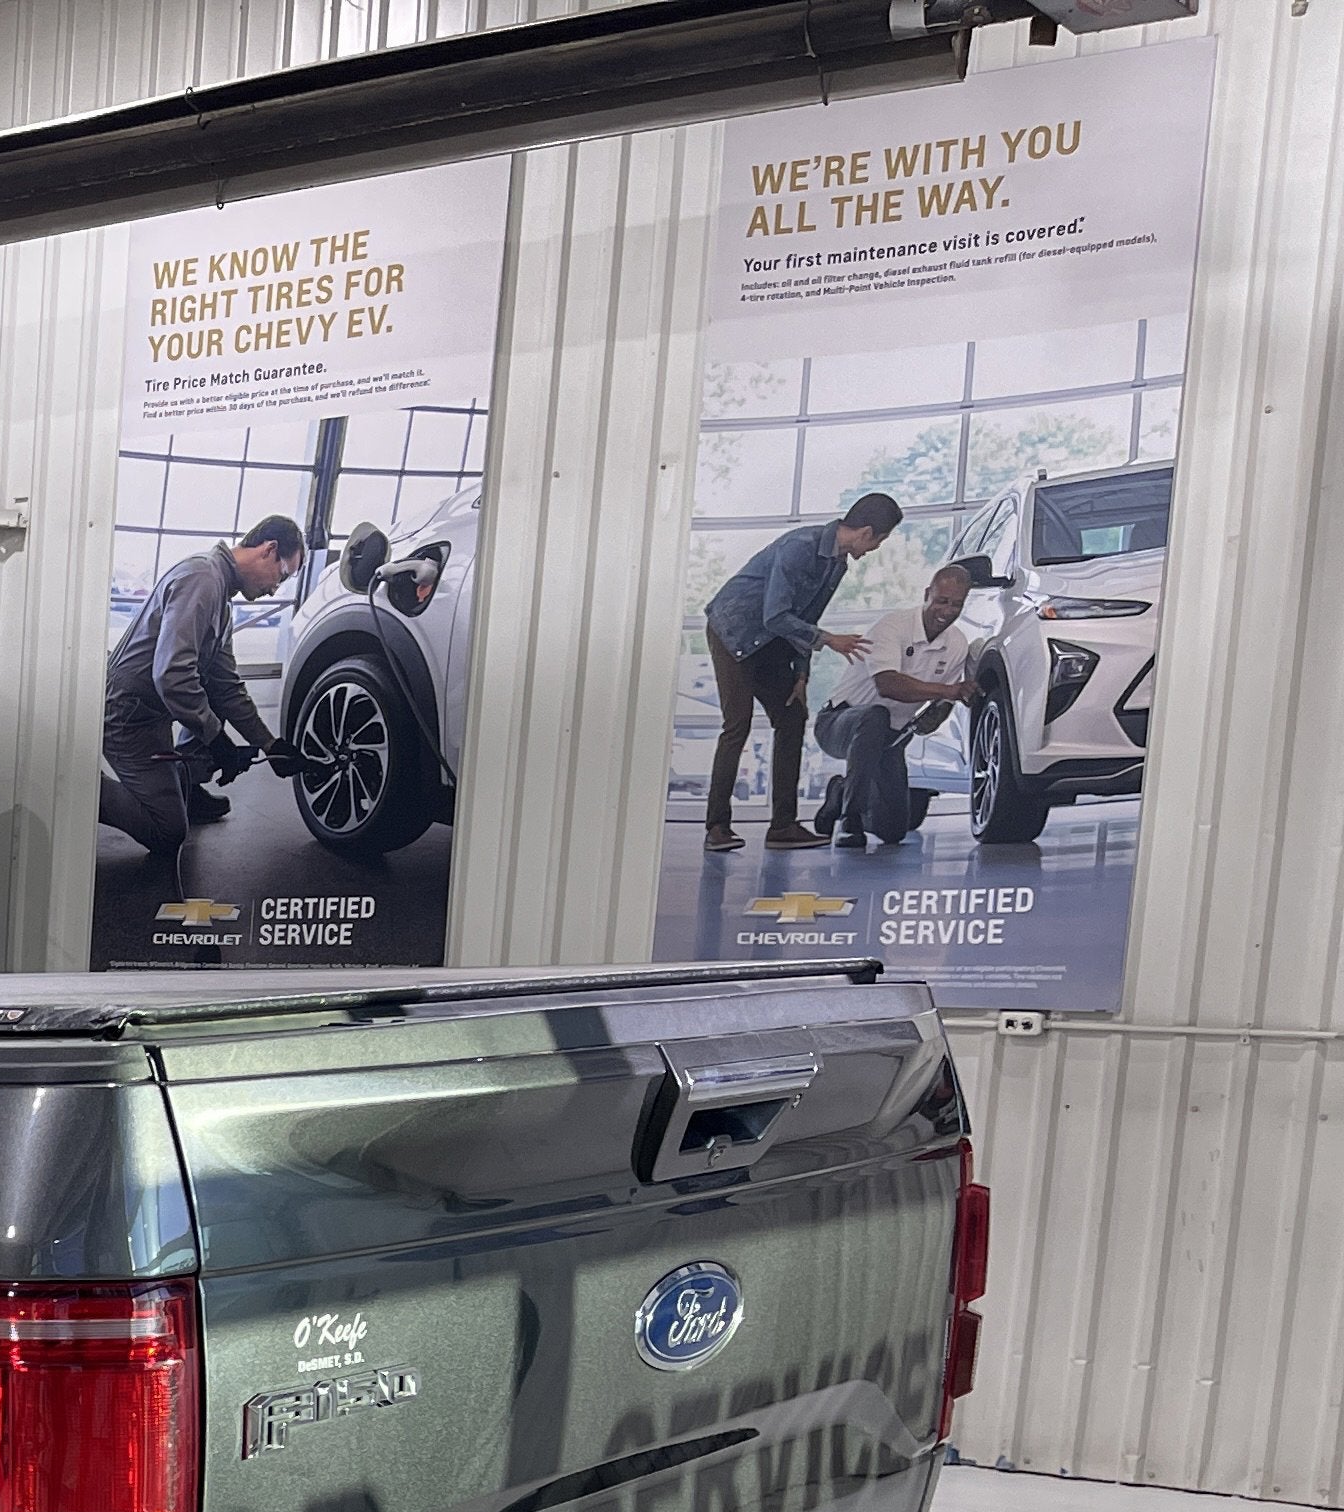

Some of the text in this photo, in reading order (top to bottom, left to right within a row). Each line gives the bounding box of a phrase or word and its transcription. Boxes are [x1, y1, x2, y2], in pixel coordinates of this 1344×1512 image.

[752, 120, 1082, 196] WE'RE WITH YOU
[746, 175, 1010, 237] ALL THE WAY.
[153, 229, 370, 290] WE KNOW THE
[741, 232, 1158, 291] Includes: oil and oil filter change, diesel exhaust fluid tank refill (for diesel-equipped models).
[743, 257, 781, 273] Your
[785, 252, 822, 269] first
[827, 240, 938, 265] maintenance
[943, 233, 980, 252] visit
[985, 230, 999, 246] is
[150, 263, 405, 327] RIGHT TIRES FOR
[766, 290, 803, 301] rotation,
[805, 287, 822, 298] and
[823, 282, 871, 297] Multi-Point
[873, 278, 905, 291] Vehicle
[906, 274, 956, 288] Inspection.
[148, 303, 394, 363] YOUR CHEVY EV.
[143, 400, 169, 409] Provide
[179, 397, 194, 406] with
[202, 394, 223, 404] better
[225, 391, 250, 402] eligible
[251, 389, 269, 400] price
[271, 388, 278, 396] at
[280, 386, 292, 395] the
[293, 384, 309, 393] time
[311, 382, 319, 391] of
[320, 379, 355, 391] purchase,
[357, 376, 371, 385] and
[391, 369, 415, 380] match
[145, 362, 327, 392] Tire Price Match Guarantee.
[143, 411, 157, 419] Find
[164, 408, 185, 418] better
[186, 407, 204, 417] price
[205, 404, 227, 413] within
[238, 401, 255, 410] days
[256, 400, 264, 408] of
[266, 399, 277, 407] the
[278, 395, 313, 407] purchase,
[315, 392, 328, 402] and
[348, 387, 373, 397] refund
[375, 385, 387, 393] the
[261, 896, 377, 921] CERTIFIED
[882, 887, 1035, 916] CERTIFIED
[152, 933, 243, 946] CHEVROLET
[258, 923, 354, 946] SERVICE
[736, 931, 858, 946] CHEVROLET
[879, 918, 1007, 946] SERVICE
[292, 1312, 368, 1350] O'Keefe
[667, 1286, 727, 1349] Ford
[297, 1351, 365, 1373] DeSMET, S.D.
